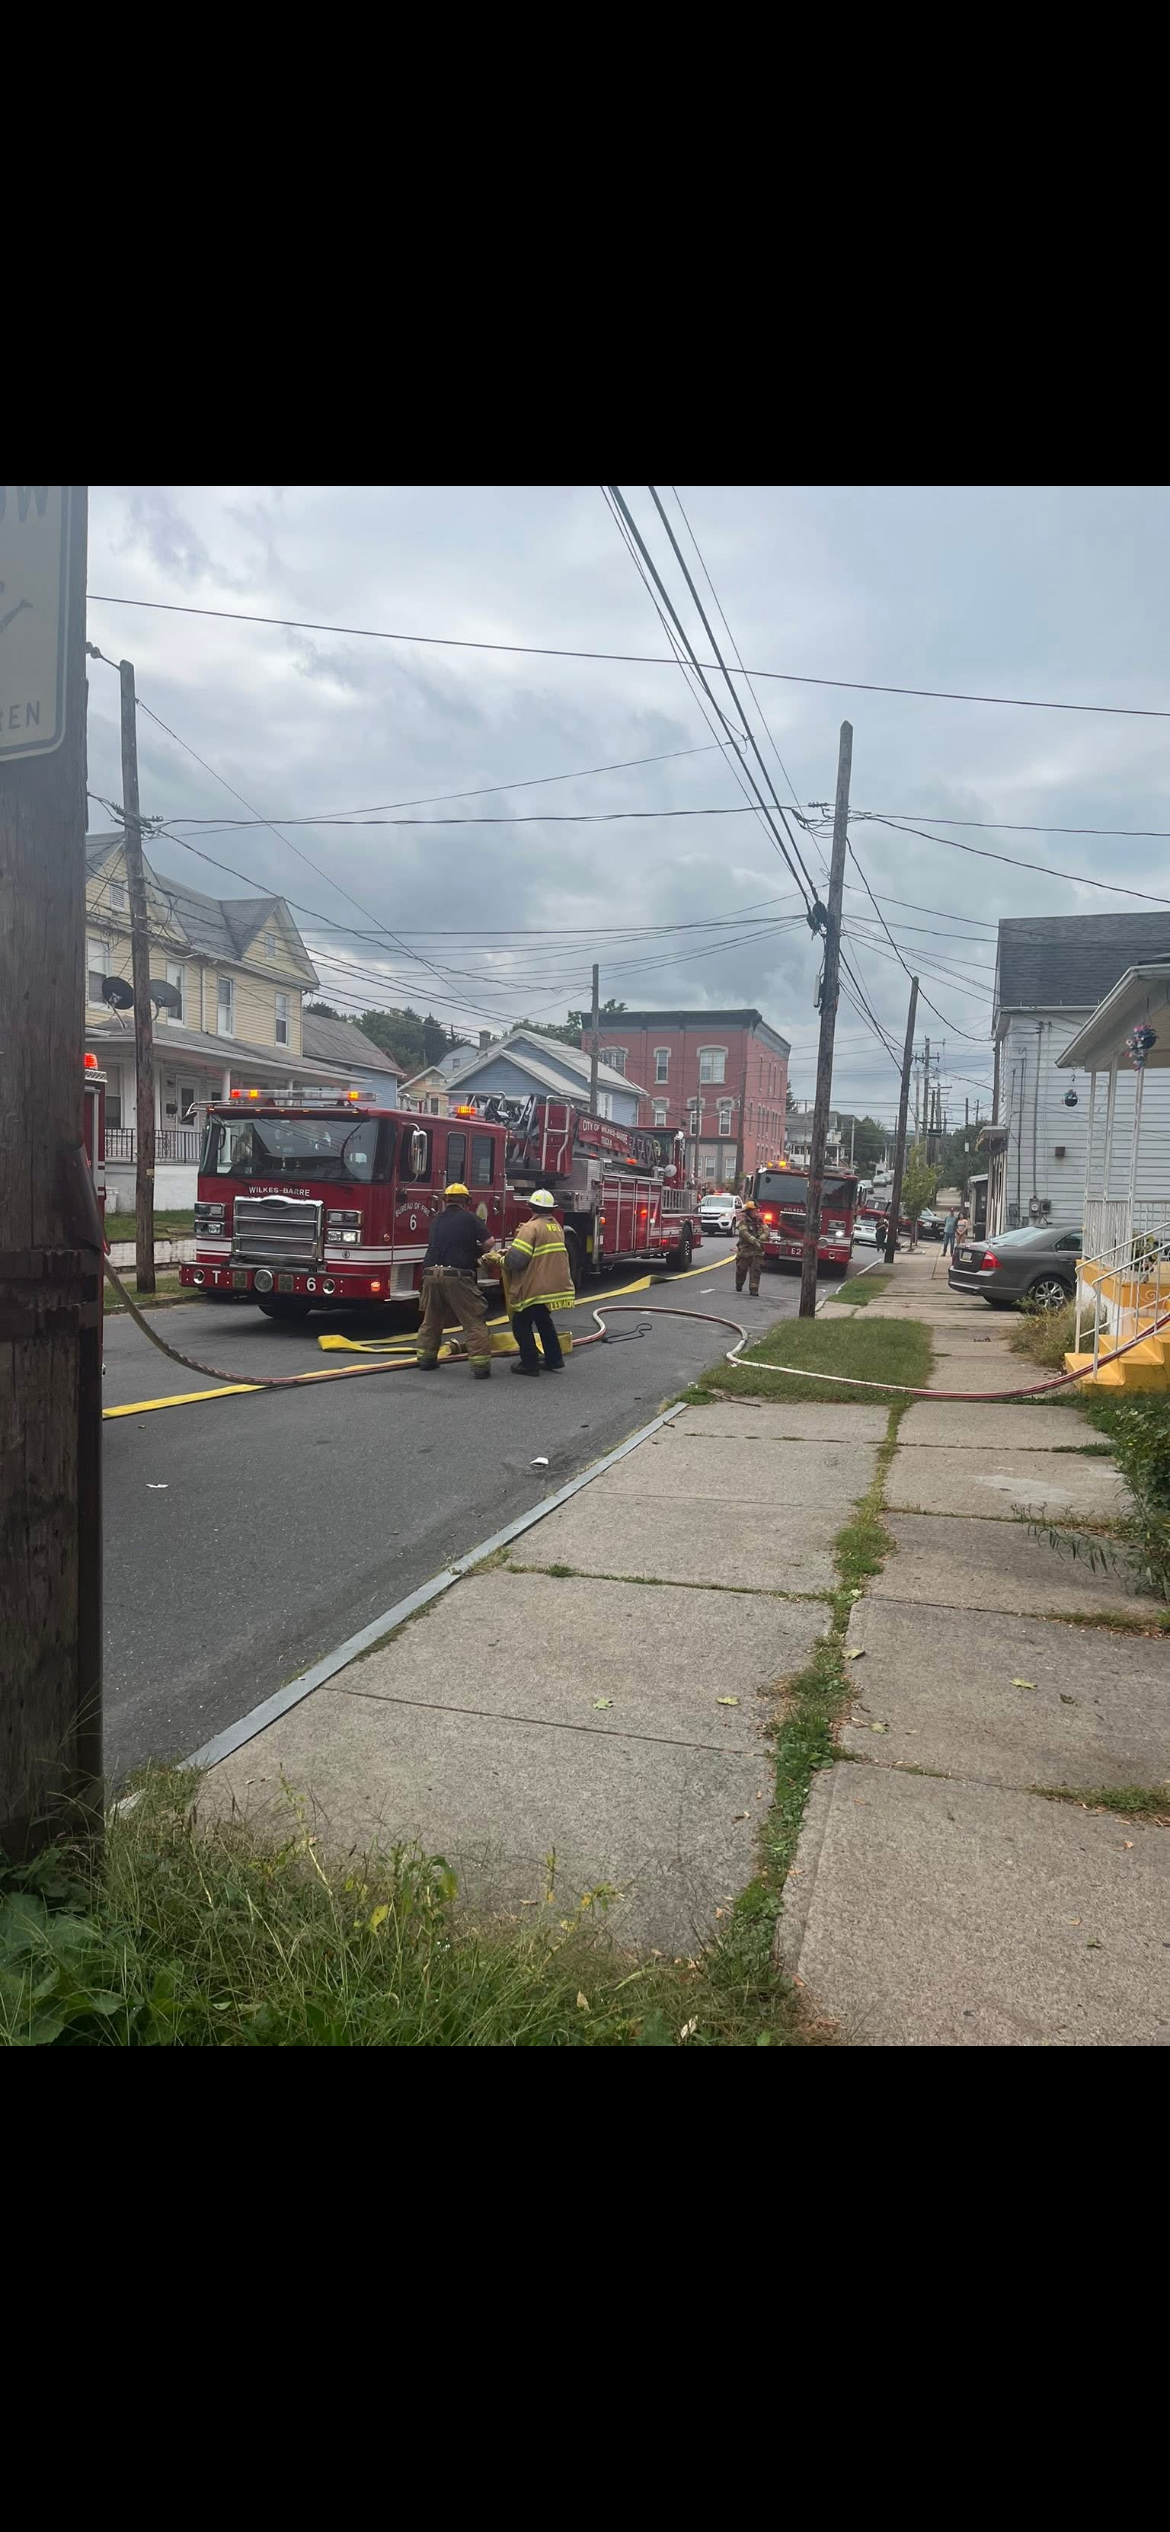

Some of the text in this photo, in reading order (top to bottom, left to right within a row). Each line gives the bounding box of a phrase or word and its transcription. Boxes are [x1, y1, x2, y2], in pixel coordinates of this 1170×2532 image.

[0, 700, 40, 731] EN
[582, 1120, 593, 1132] CITY
[593, 1123, 601, 1131] OF
[248, 1186, 311, 1197] WILKES-BARRE
[414, 1202, 421, 1210] OF
[410, 1214, 417, 1231] 6
[791, 1247, 802, 1255] E2
[212, 1270, 317, 1291] T 6
